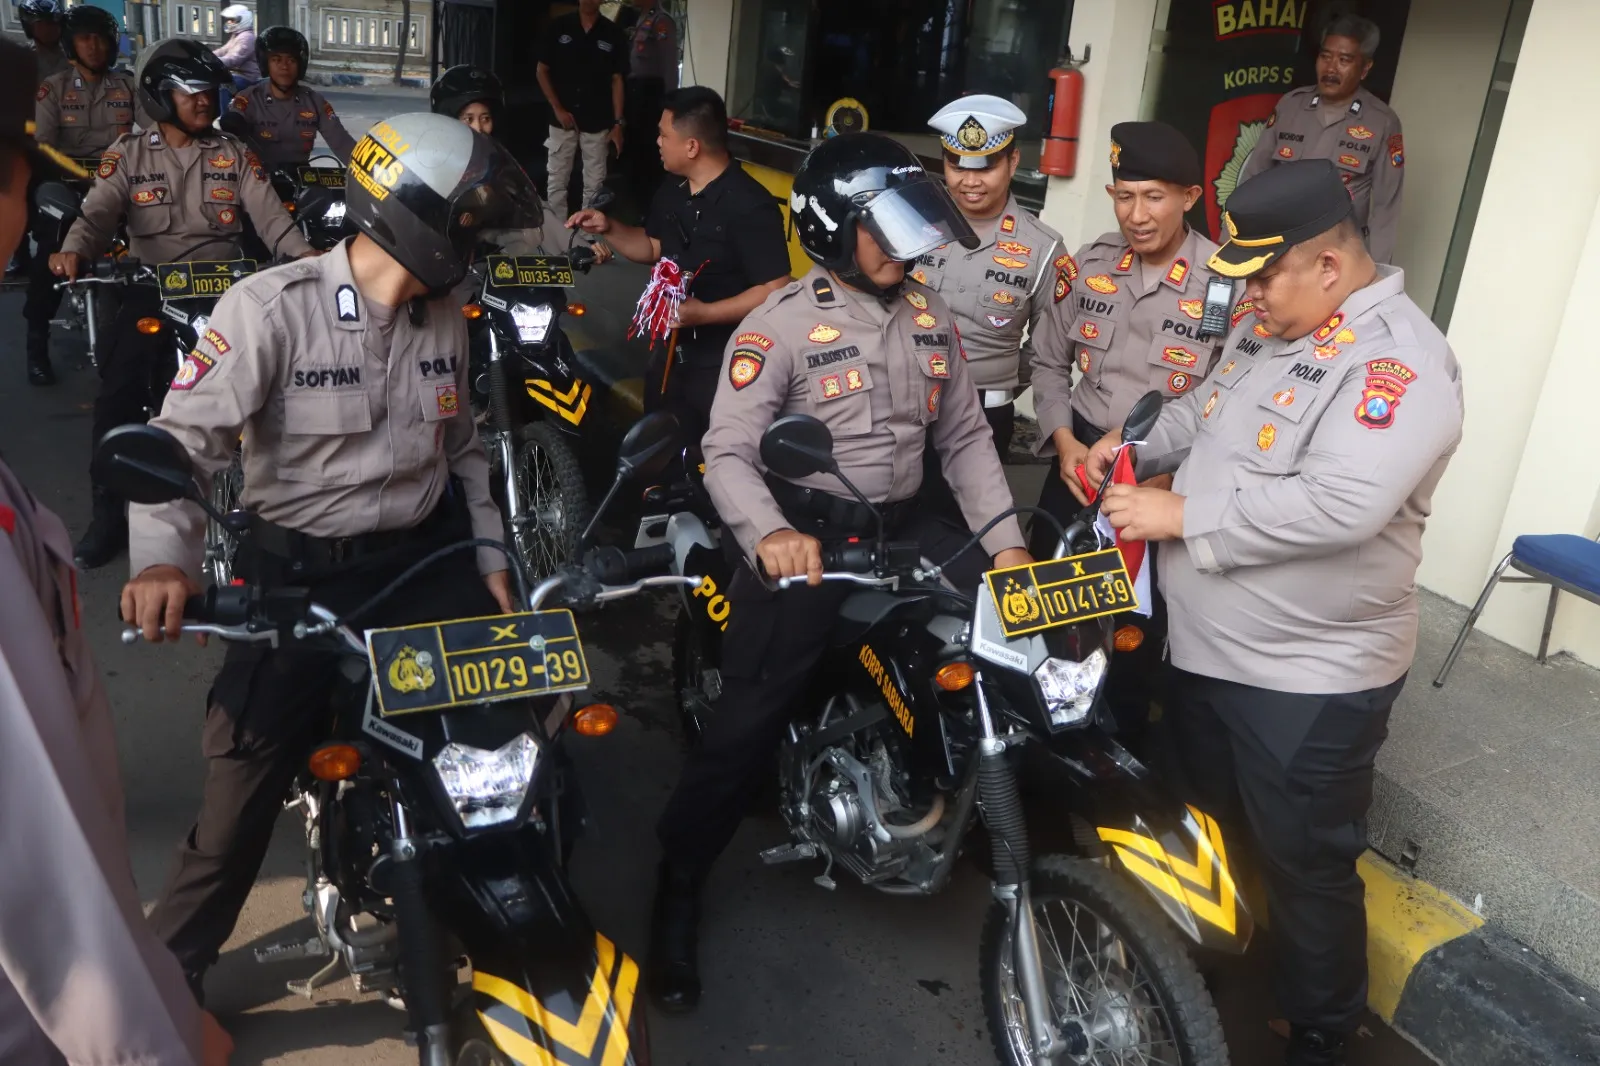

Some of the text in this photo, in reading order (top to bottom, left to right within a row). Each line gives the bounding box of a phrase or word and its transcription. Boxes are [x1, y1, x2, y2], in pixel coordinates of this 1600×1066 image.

[1224, 66, 1295, 90] KORPS S
[1338, 140, 1371, 154] POLRI
[203, 172, 238, 182] POLRI
[194, 278, 231, 293] 10138
[984, 268, 1028, 289] POLRI
[1080, 296, 1114, 316] RUDI
[911, 333, 949, 347] POLRI
[1235, 337, 1263, 357] DANI
[294, 367, 361, 388] SOFYAN
[1288, 362, 1328, 385] POLRI
[692, 575, 731, 632] PO
[1043, 578, 1130, 618] 10141-39
[489, 623, 519, 642] X
[979, 642, 1025, 666] Kawasaki
[858, 644, 916, 740] KORPS SABHARA
[368, 719, 421, 752] Kawasaki
